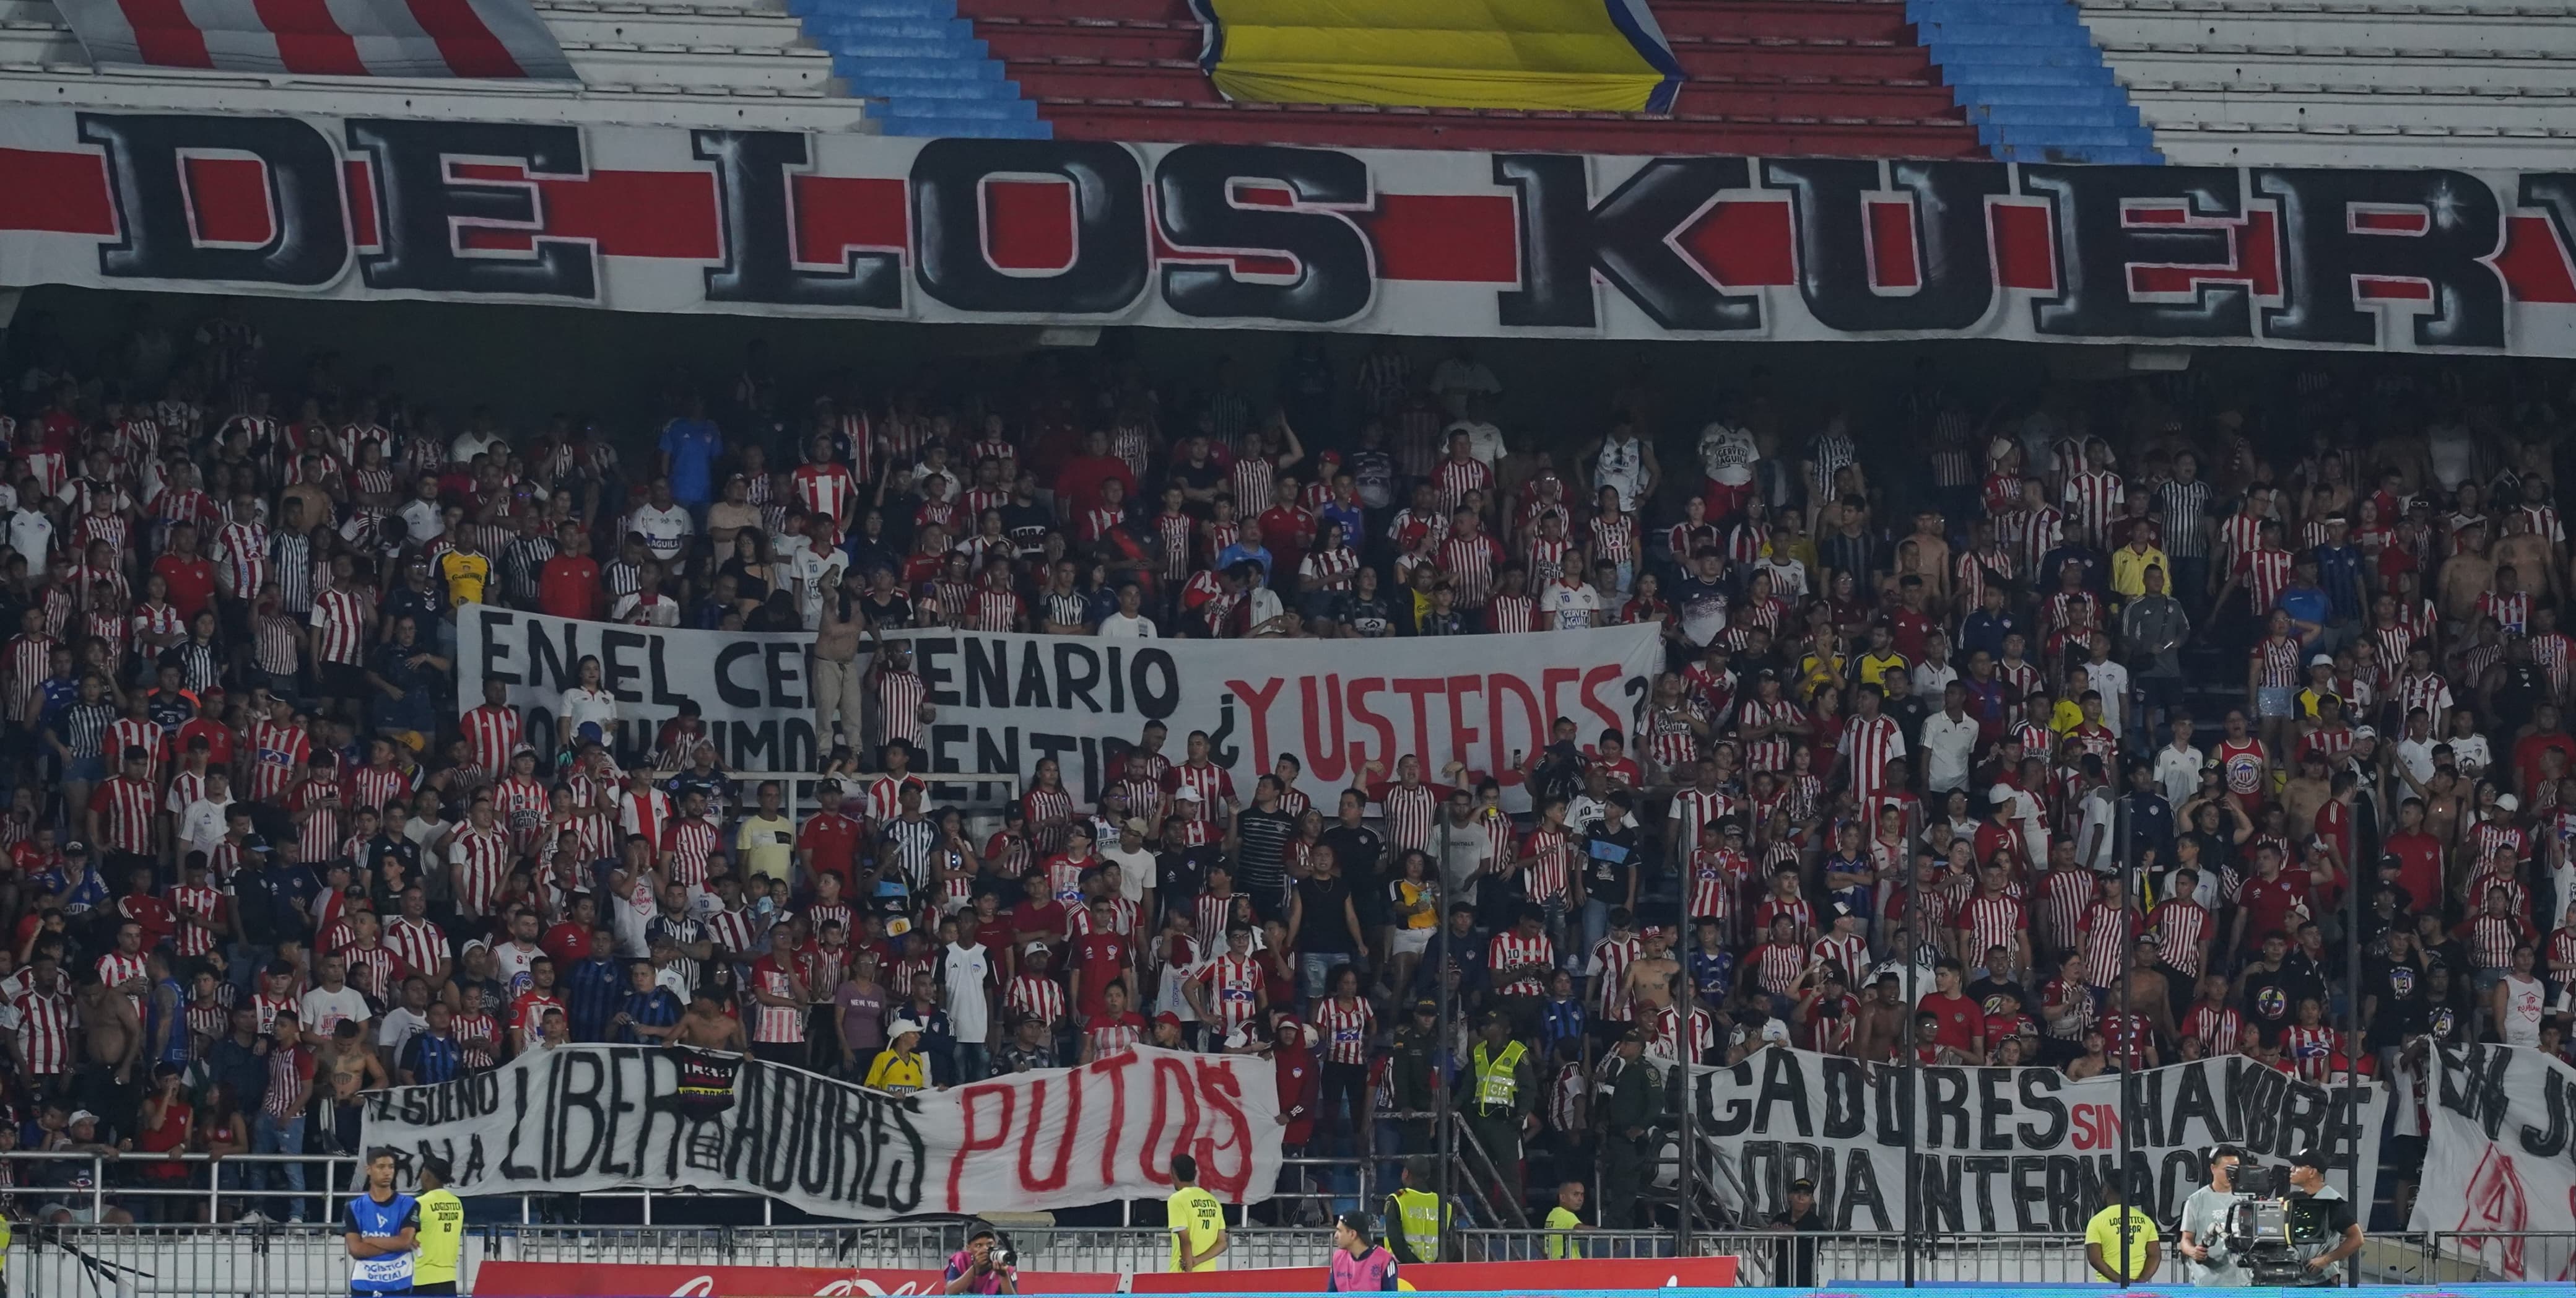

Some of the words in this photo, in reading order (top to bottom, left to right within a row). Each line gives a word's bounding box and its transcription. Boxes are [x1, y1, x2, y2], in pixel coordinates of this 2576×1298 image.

[75, 110, 597, 300] DE
[690, 129, 1373, 318] LOS
[1560, 595, 1570, 603] 10
[480, 611, 579, 694] EN
[602, 628, 688, 706] EL
[713, 640, 1180, 720] CEENARIO
[513, 795, 523, 806] 10
[1099, 828, 1107, 839] 10
[699, 899, 709, 908] 10
[1508, 949, 1520, 959] 10
[850, 998, 865, 1006] NEW
[262, 1006, 272, 1019] 10
[2128, 1055, 2373, 1170] HAMBRE
[437, 1212, 459, 1221] JUNIOR
[1201, 1219, 1211, 1230] 70
